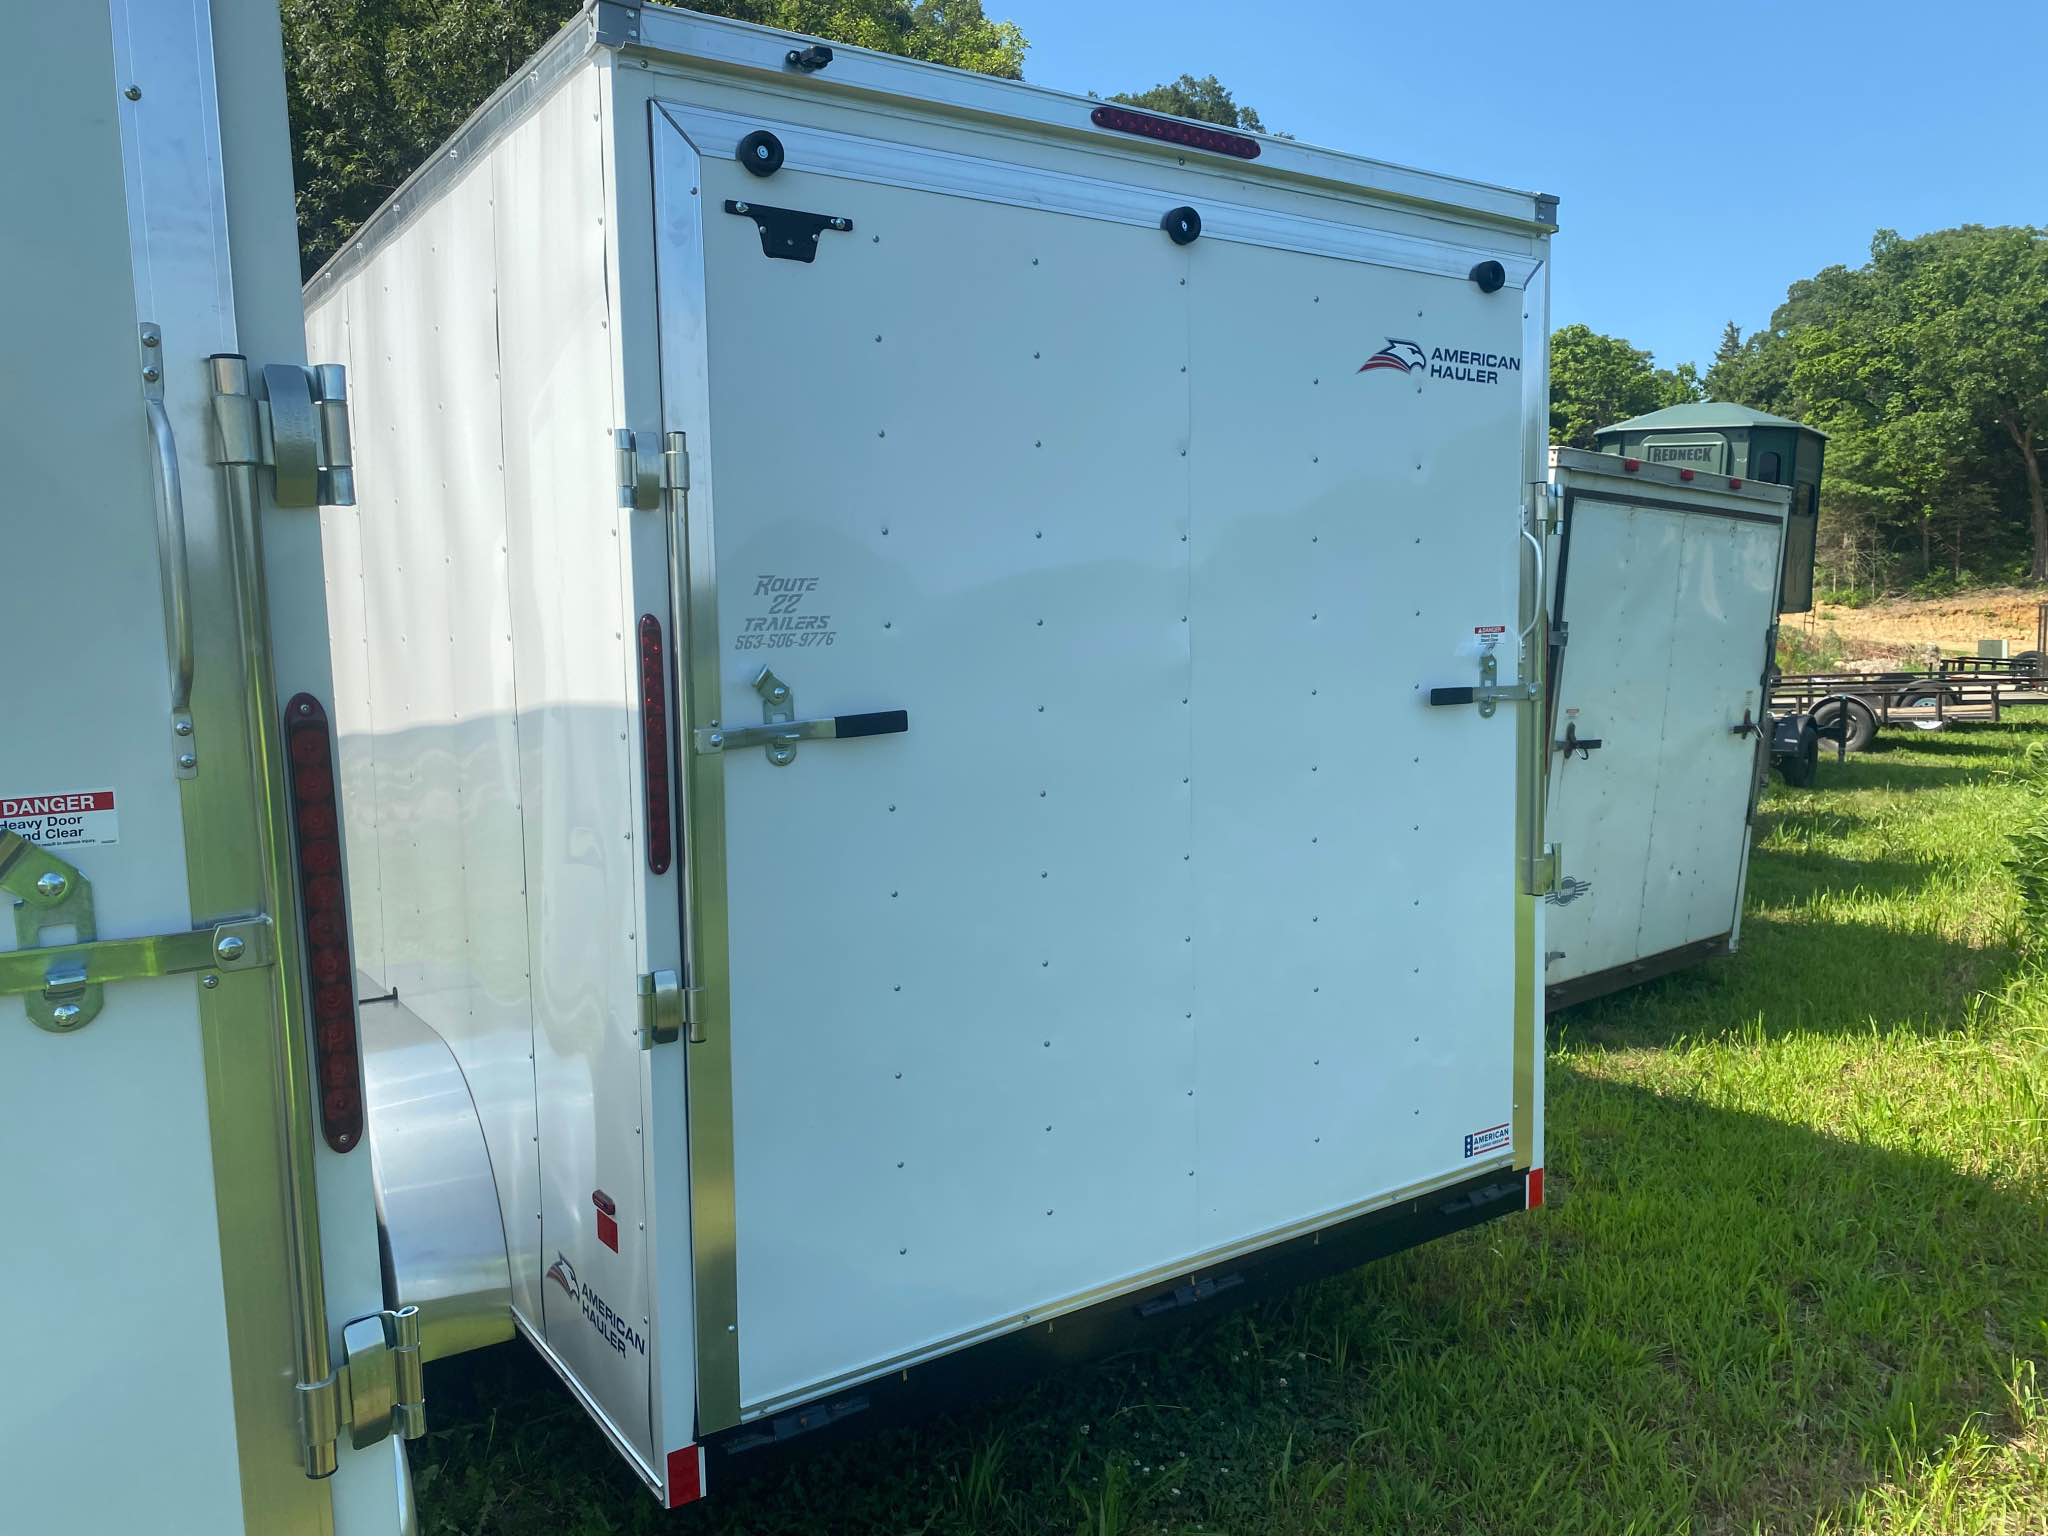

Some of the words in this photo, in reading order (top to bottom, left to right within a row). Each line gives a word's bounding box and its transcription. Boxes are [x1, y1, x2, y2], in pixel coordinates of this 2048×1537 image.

[1431, 347, 1521, 371] AMERICAN
[1430, 364, 1498, 385] HAULER
[1653, 447, 1712, 462] REDNECK
[768, 593, 803, 615] 22
[744, 615, 831, 632] TRAILERS
[735, 632, 837, 650] 563-506-9776
[2, 794, 95, 816] DANGER
[47, 816, 83, 827] Door
[45, 828, 84, 840] Clear
[1473, 1128, 1509, 1146] AMERICAN
[582, 1282, 645, 1356] AMERICAN
[582, 1300, 626, 1359] HAULER
